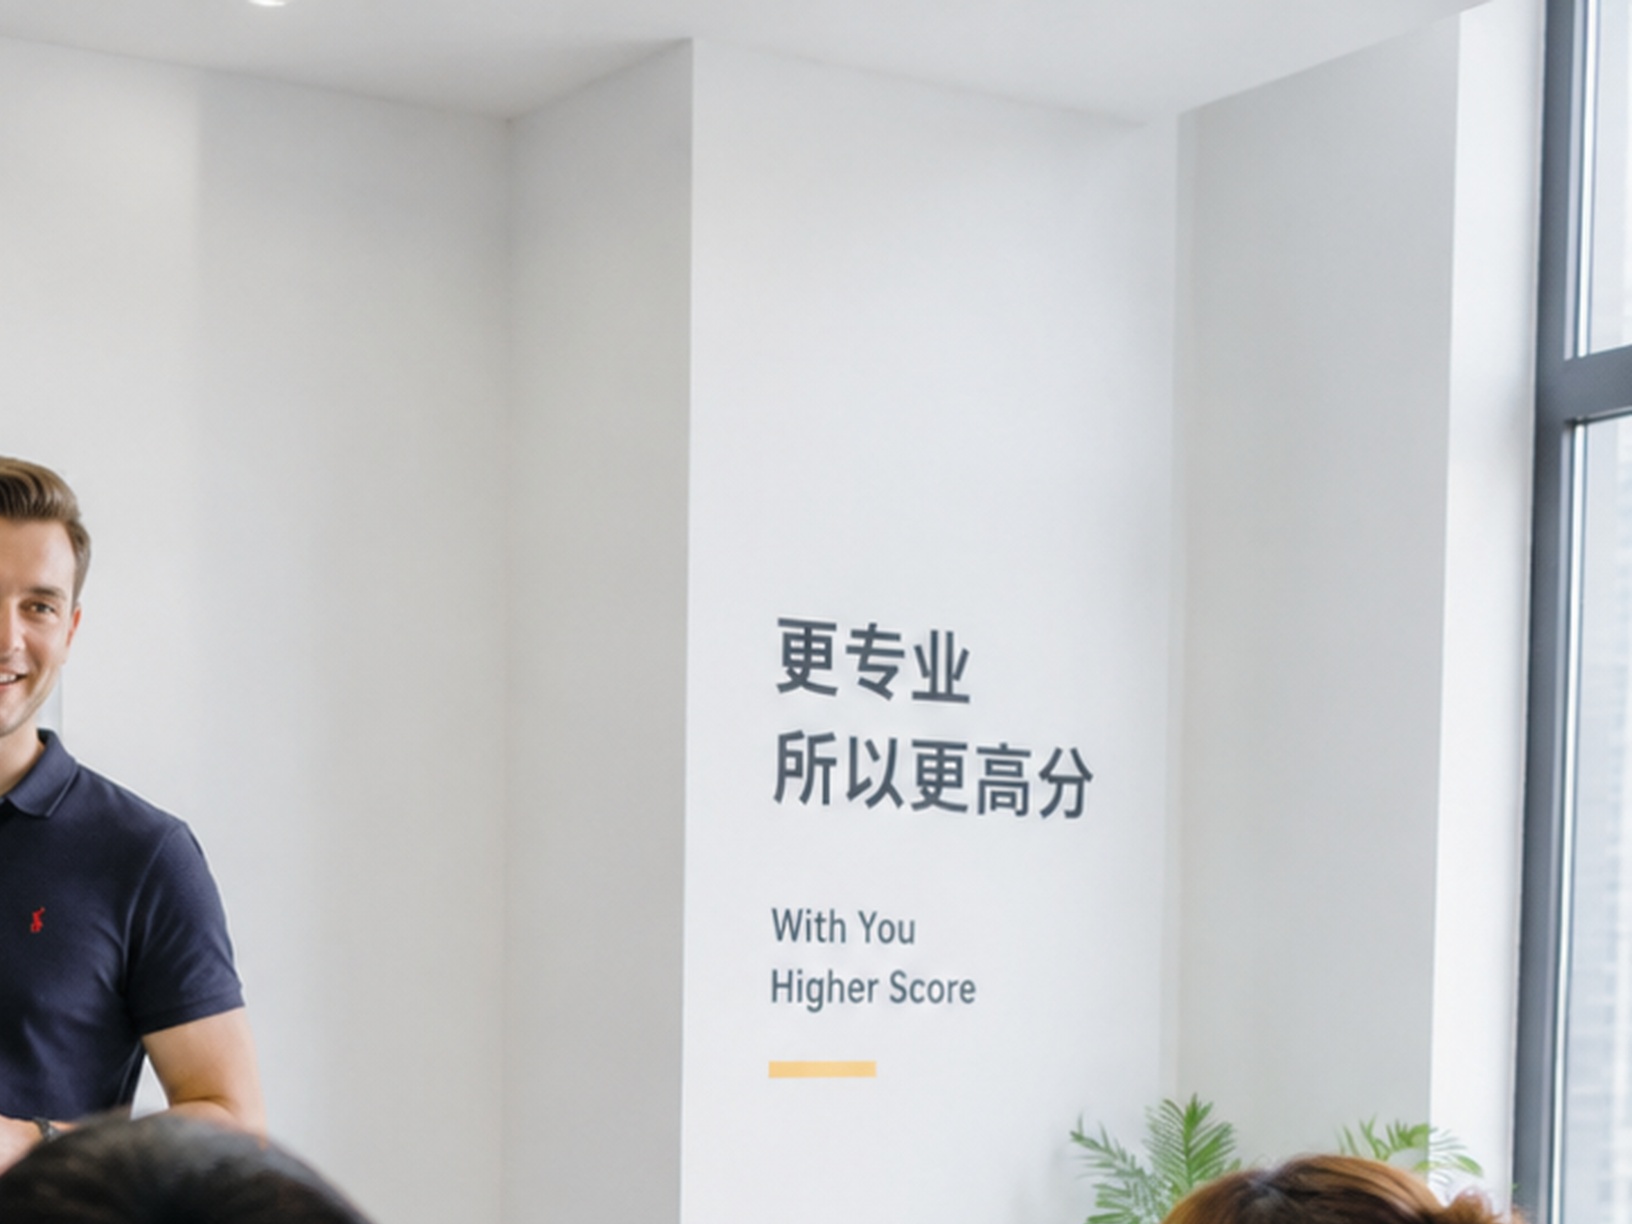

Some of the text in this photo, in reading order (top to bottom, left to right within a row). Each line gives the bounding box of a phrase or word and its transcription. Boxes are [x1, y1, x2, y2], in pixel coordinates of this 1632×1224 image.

[774, 616, 972, 706] 更专业
[772, 728, 1095, 821] 所以更高分
[770, 906, 917, 946] With You
[770, 967, 978, 1015] Higher Score
